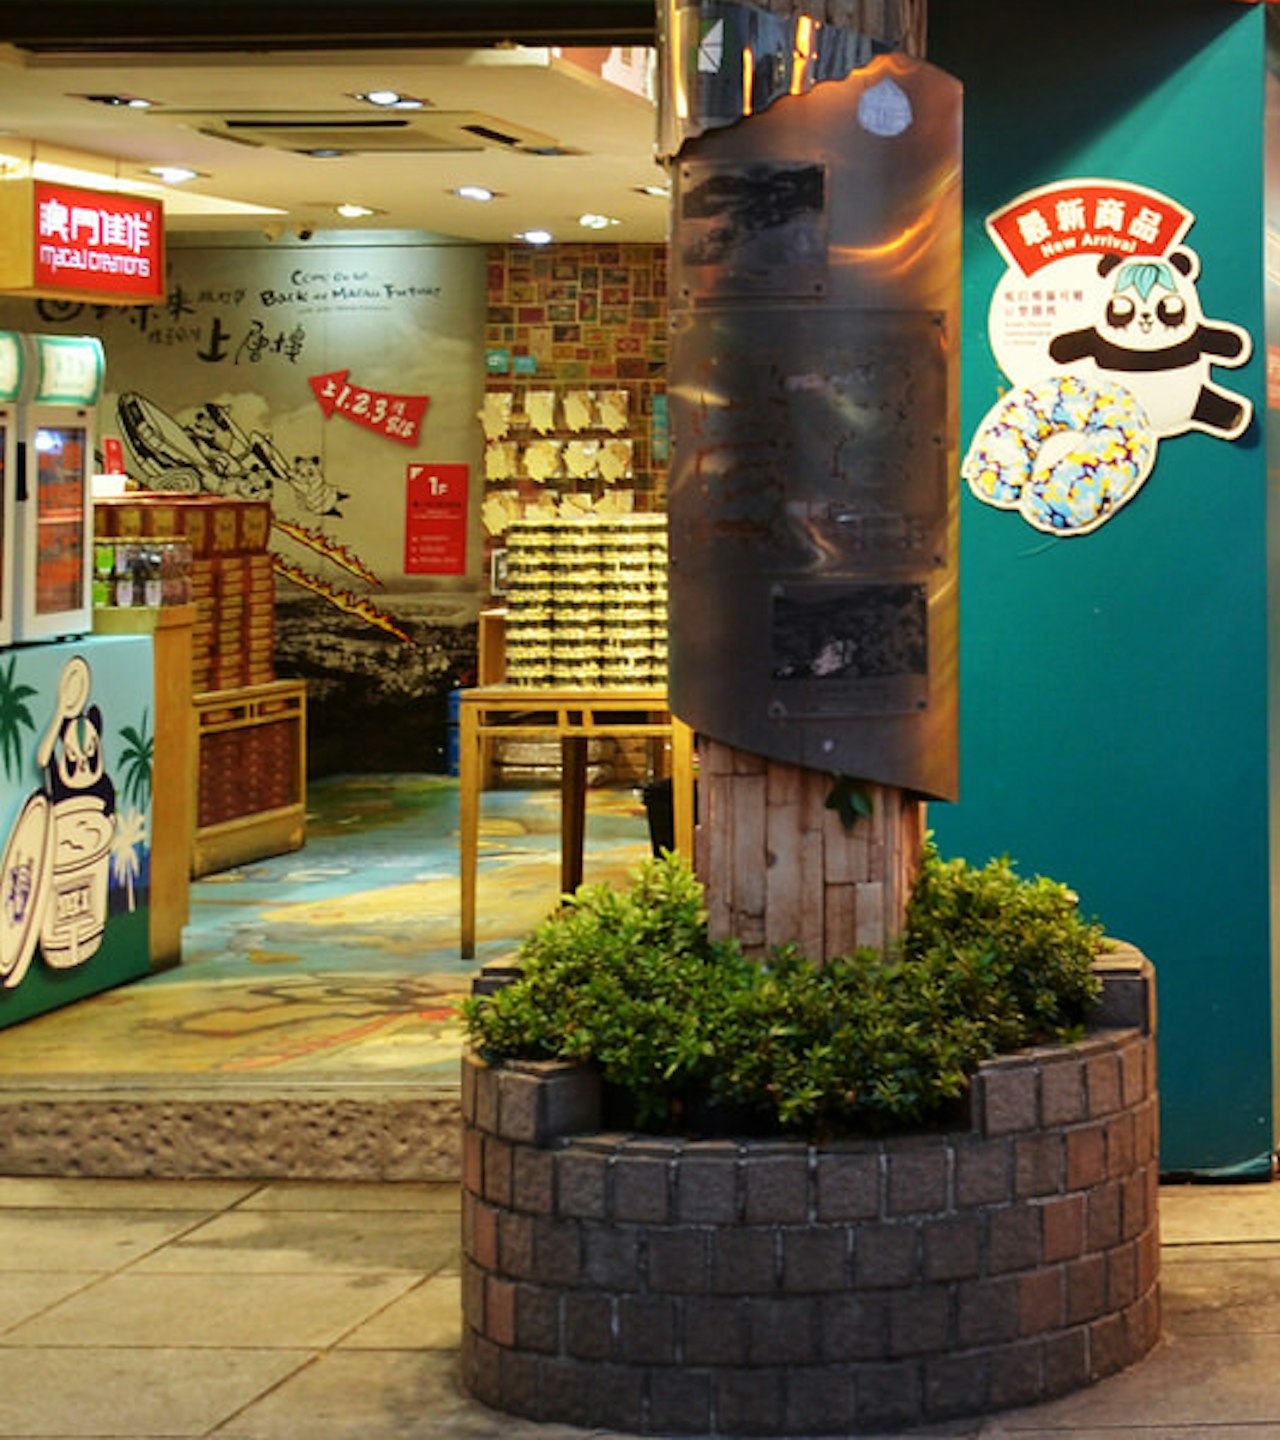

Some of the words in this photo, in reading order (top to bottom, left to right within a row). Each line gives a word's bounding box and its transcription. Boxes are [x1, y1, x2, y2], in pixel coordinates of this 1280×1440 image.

[39, 198, 150, 253] 澳門佳作
[1016, 197, 1165, 246] 最新商品
[1041, 238, 1077, 258] New
[1081, 233, 1137, 254] Arrival
